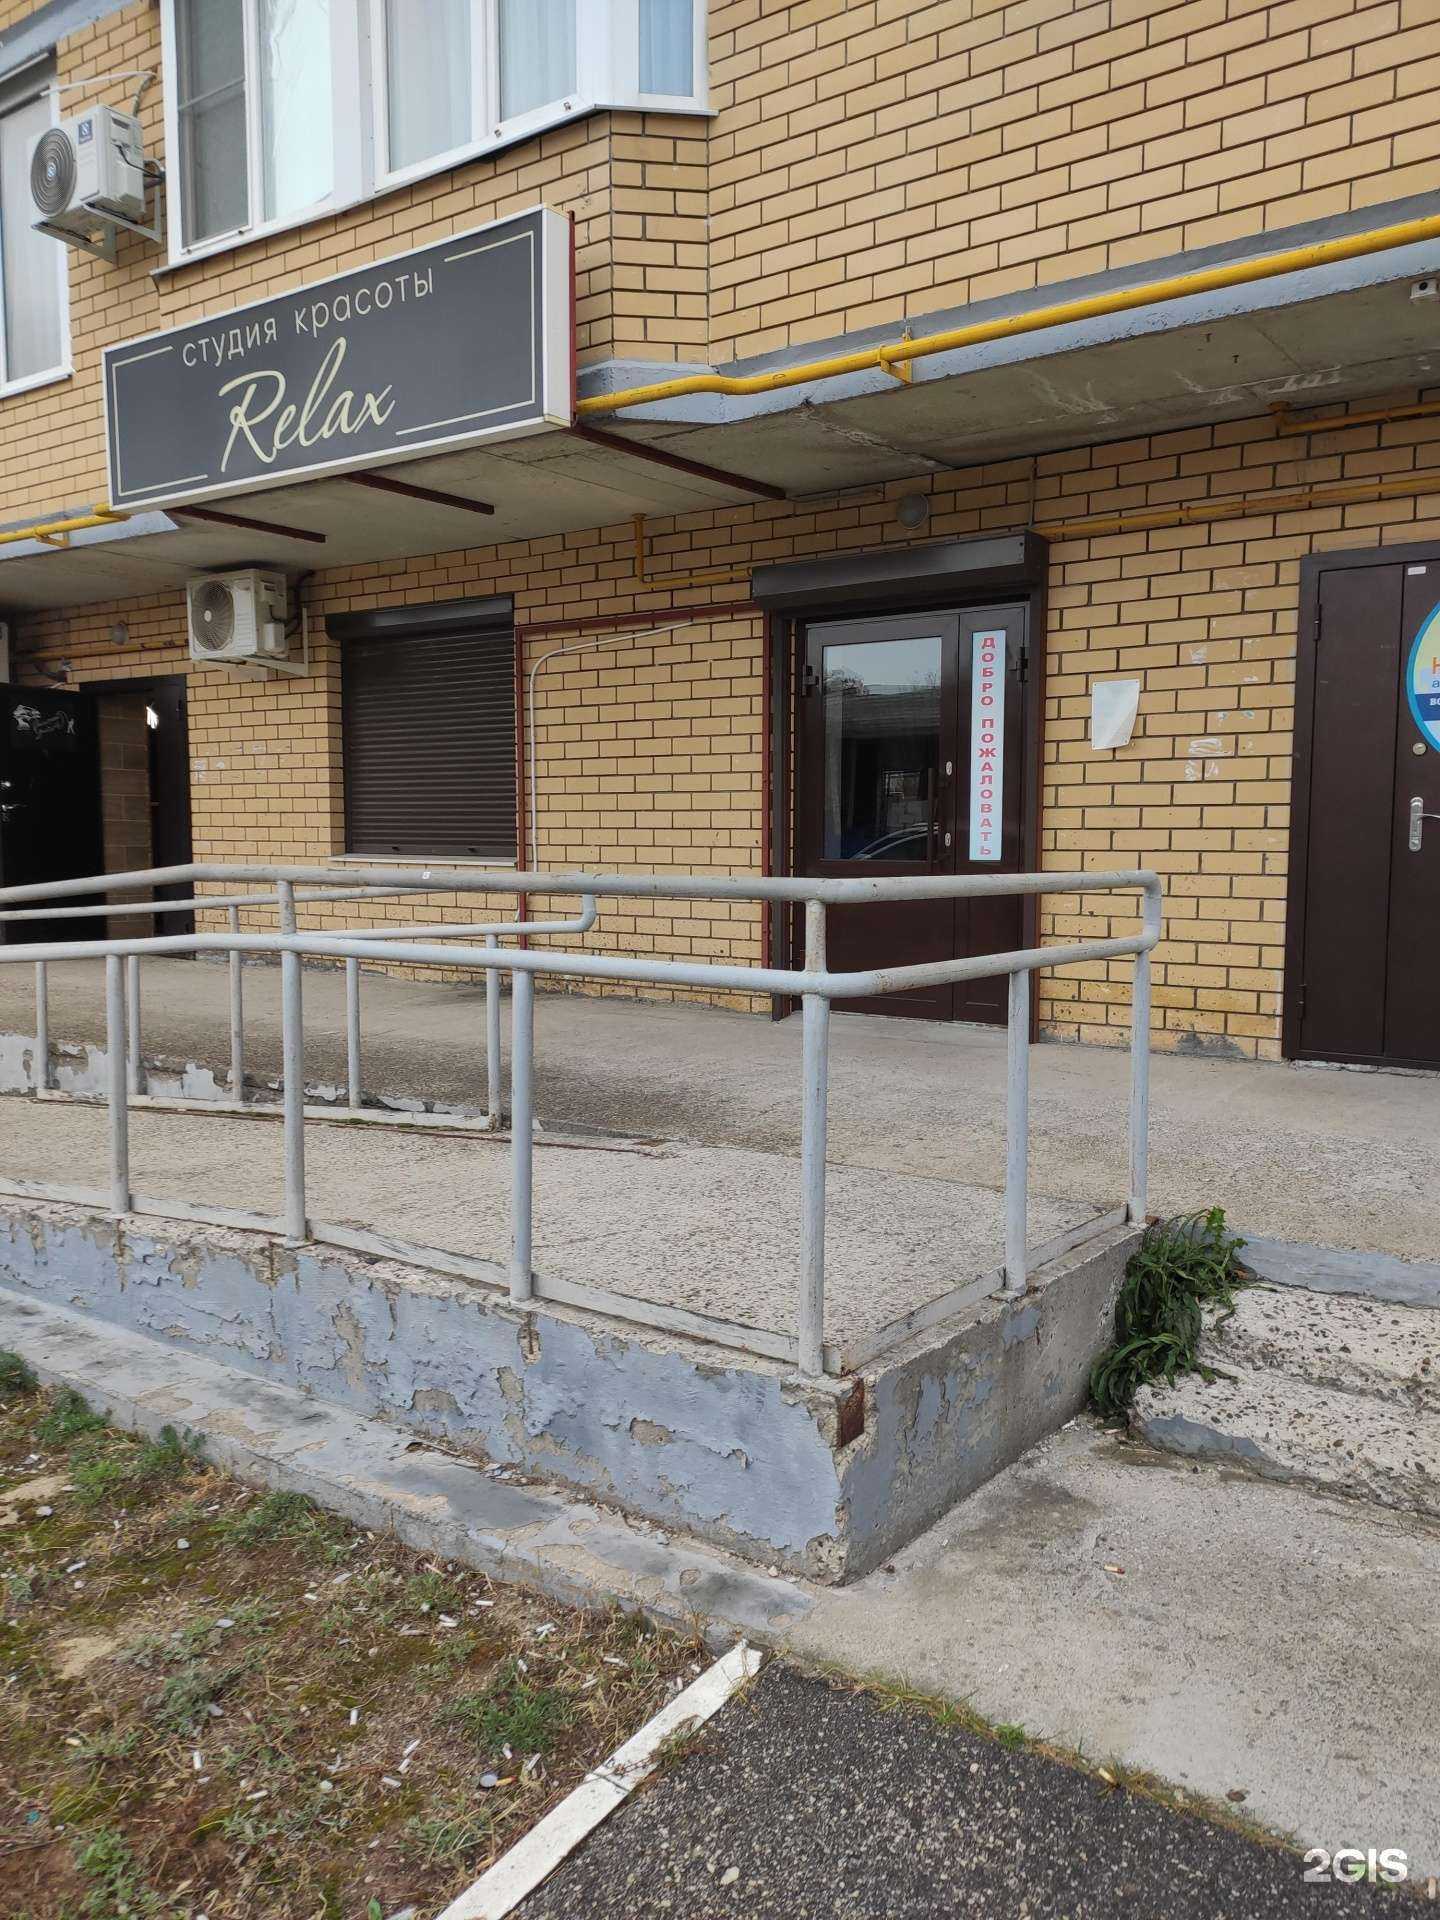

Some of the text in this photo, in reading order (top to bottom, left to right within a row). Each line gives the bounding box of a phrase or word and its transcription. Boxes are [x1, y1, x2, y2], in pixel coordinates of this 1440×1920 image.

[183, 268, 433, 367] студия красоты
[218, 337, 395, 472] Relax
[979, 637, 997, 856] ДОБРО ПОЖАЛОВАТЬ
